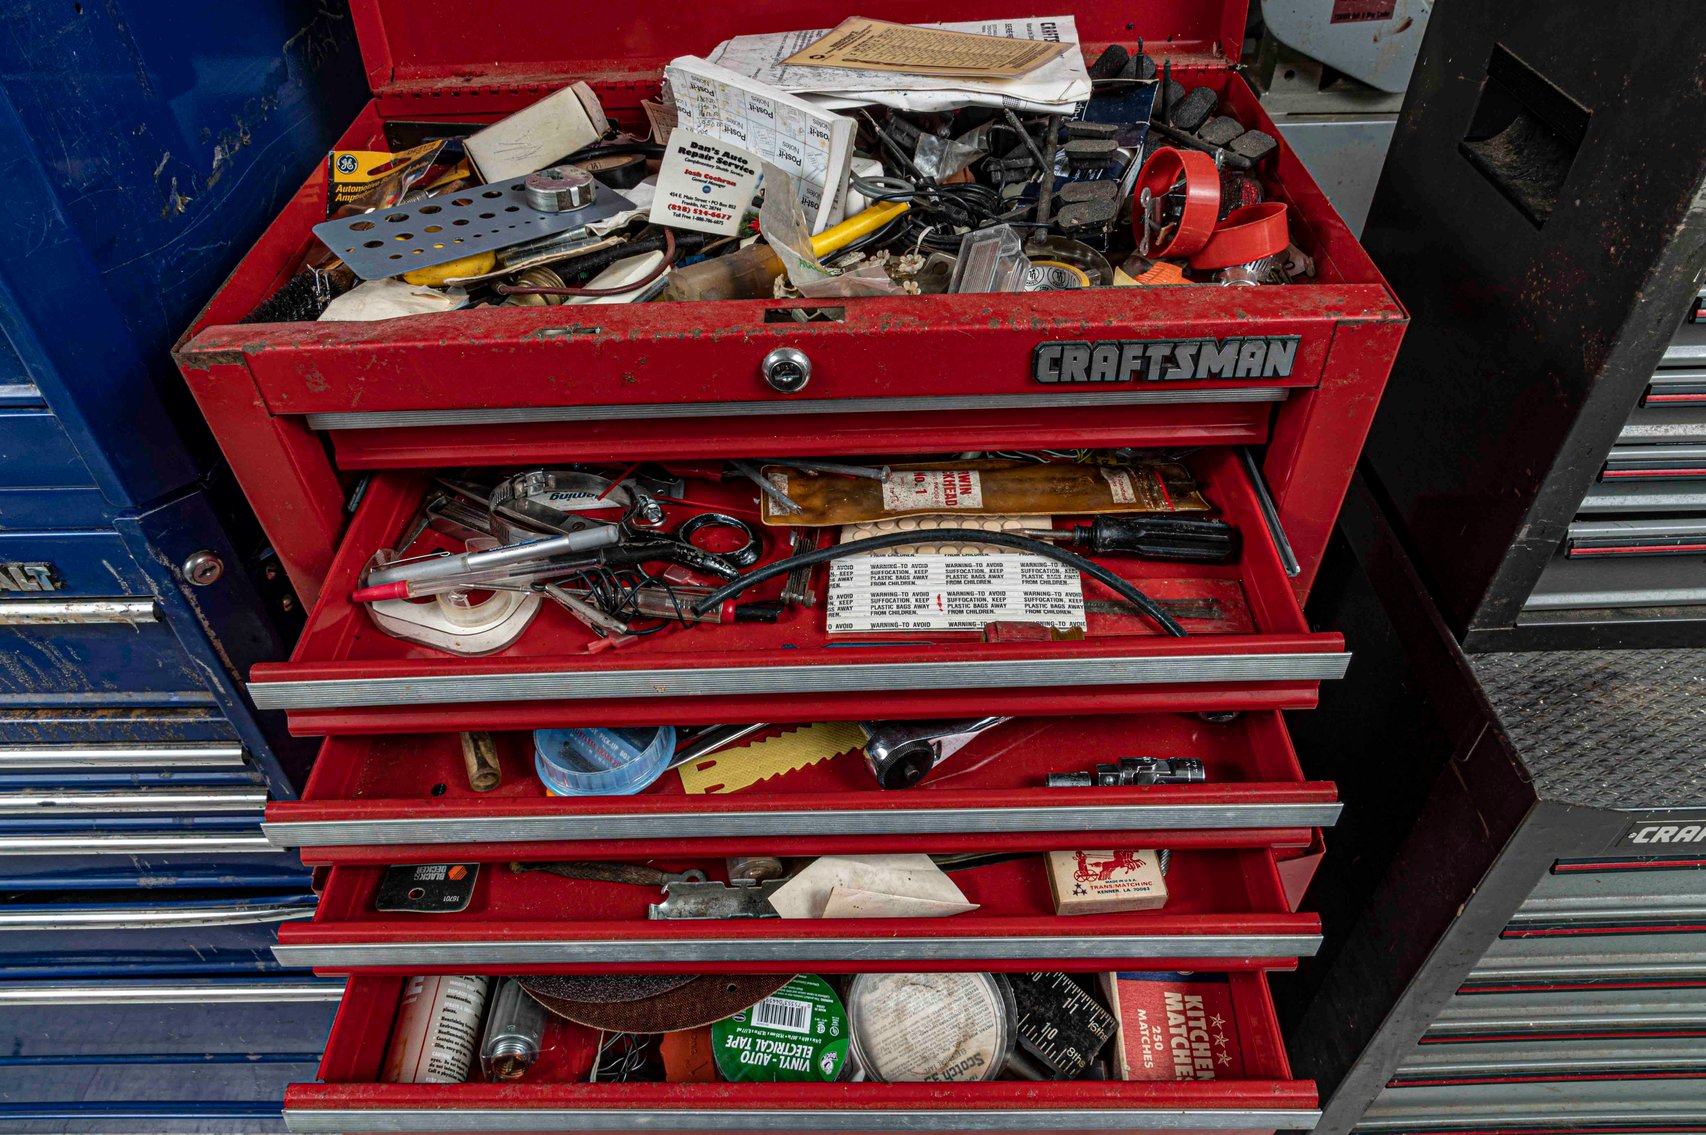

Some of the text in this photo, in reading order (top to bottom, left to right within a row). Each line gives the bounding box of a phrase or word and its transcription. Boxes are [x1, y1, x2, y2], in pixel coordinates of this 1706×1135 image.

[689, 82, 714, 97] Post-it
[751, 95, 770, 108] Notes
[677, 106, 692, 118] Pos
[748, 103, 774, 119] Post-it
[724, 125, 746, 141] Post-it
[809, 124, 830, 142] ost-it
[690, 141, 748, 165] Dan's Auto
[782, 141, 800, 154] Notes
[678, 146, 755, 176] Repair Service
[778, 150, 802, 166] Post-it
[684, 158, 744, 178] Complimentary Shuttle Service
[684, 168, 737, 186] Josh Cochran
[692, 176, 726, 189] General Manager
[682, 200, 699, 208] Franklin,
[801, 196, 820, 210] ost-it
[668, 204, 732, 221] (828) 524-6677
[1036, 338, 1300, 382] CRAFTSMAN
[914, 472, 926, 487] NO.
[416, 866, 447, 874] DECKER
[1041, 1022, 1058, 1040] 10
[1088, 1020, 1108, 1041] 16ths
[1137, 1008, 1154, 1069] MATCHES
[1152, 1025, 1164, 1051] 250
[1184, 995, 1216, 1080] KITCHEN
[725, 1035, 752, 1050] TAPE
[755, 1038, 814, 1058] ELECTRICAL
[740, 1051, 810, 1072] VINYL AUTO
[942, 1052, 984, 1080] Scotch
[1066, 1047, 1086, 1068] 8ths
